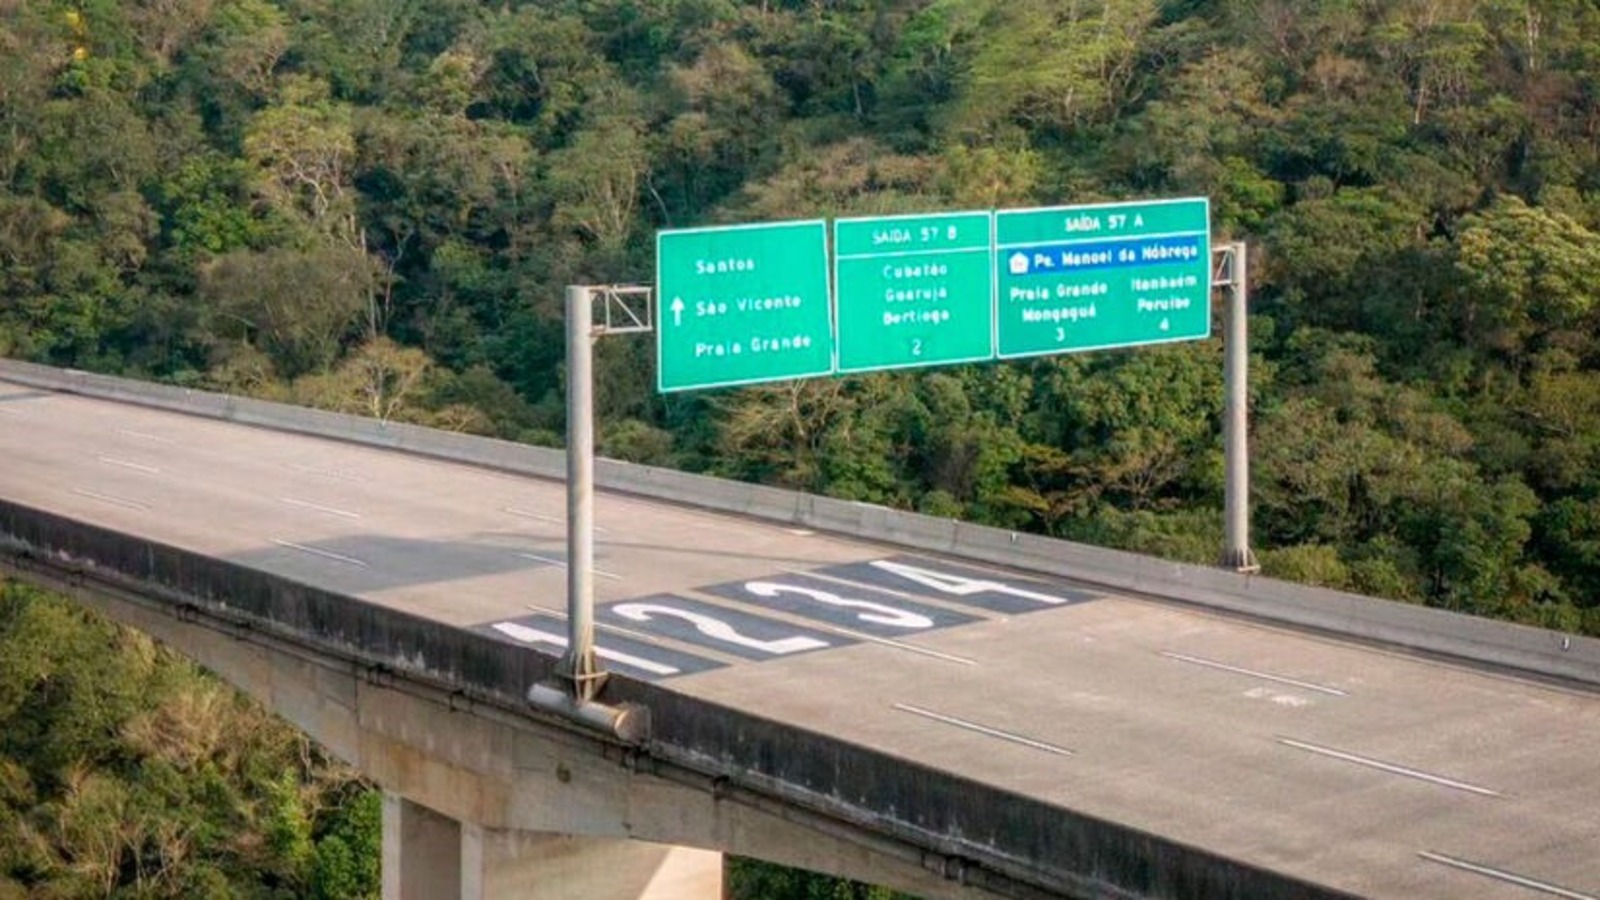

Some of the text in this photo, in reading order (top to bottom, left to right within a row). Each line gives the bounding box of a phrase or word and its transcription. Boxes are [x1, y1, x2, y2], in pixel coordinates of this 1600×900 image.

[1108, 214, 1126, 230] 57
[1134, 213, 1144, 228] A
[921, 226, 939, 242] 57
[947, 225, 957, 240] B
[696, 258, 755, 275] Santos
[1010, 281, 1108, 302] Praia Grande
[696, 295, 802, 317] São Vicente
[1055, 327, 1065, 342] 3
[1160, 317, 1170, 331] 4
[695, 336, 812, 358] Praia Grande
[911, 338, 922, 356] 2
[868, 559, 1069, 604] 4
[744, 580, 935, 629] 3
[612, 603, 831, 655] 2
[491, 622, 680, 676] 1
